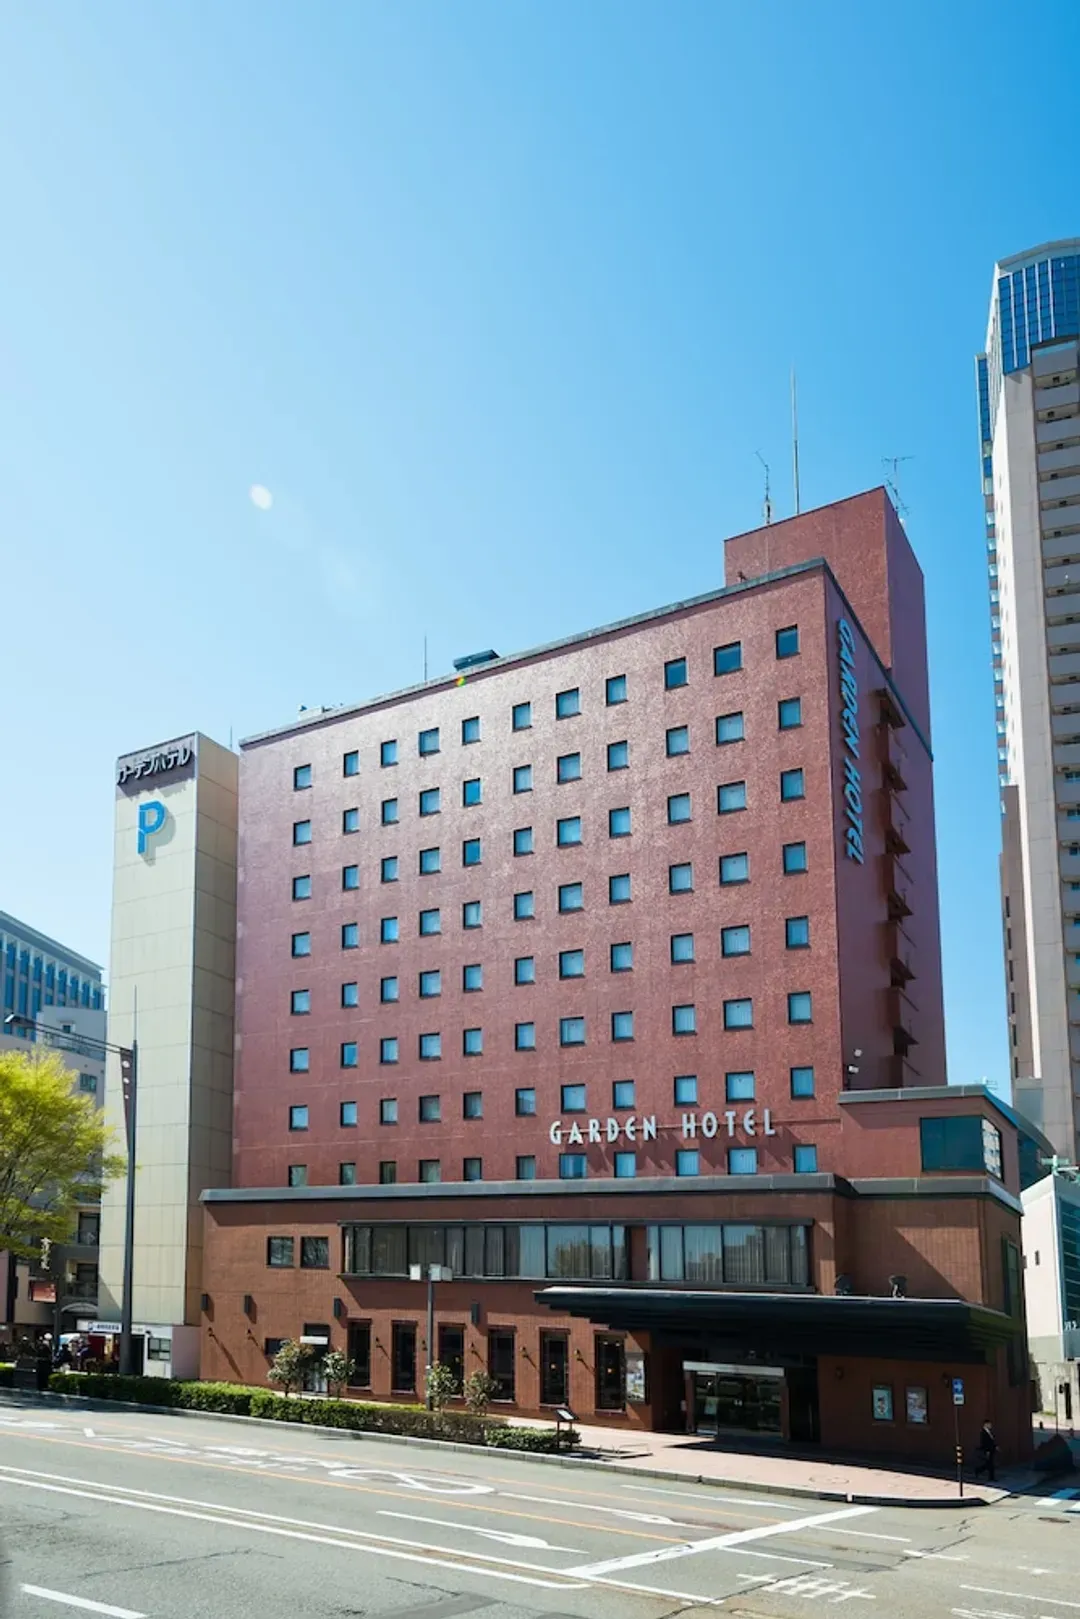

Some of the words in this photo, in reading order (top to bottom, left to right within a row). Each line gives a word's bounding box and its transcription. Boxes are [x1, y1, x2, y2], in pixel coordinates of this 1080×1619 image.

[837, 618, 860, 760] GARDEN
[137, 800, 166, 855] P
[844, 755, 864, 865] HOTEL
[550, 1115, 657, 1145] GARDEN
[682, 1108, 776, 1139] HOTEL
